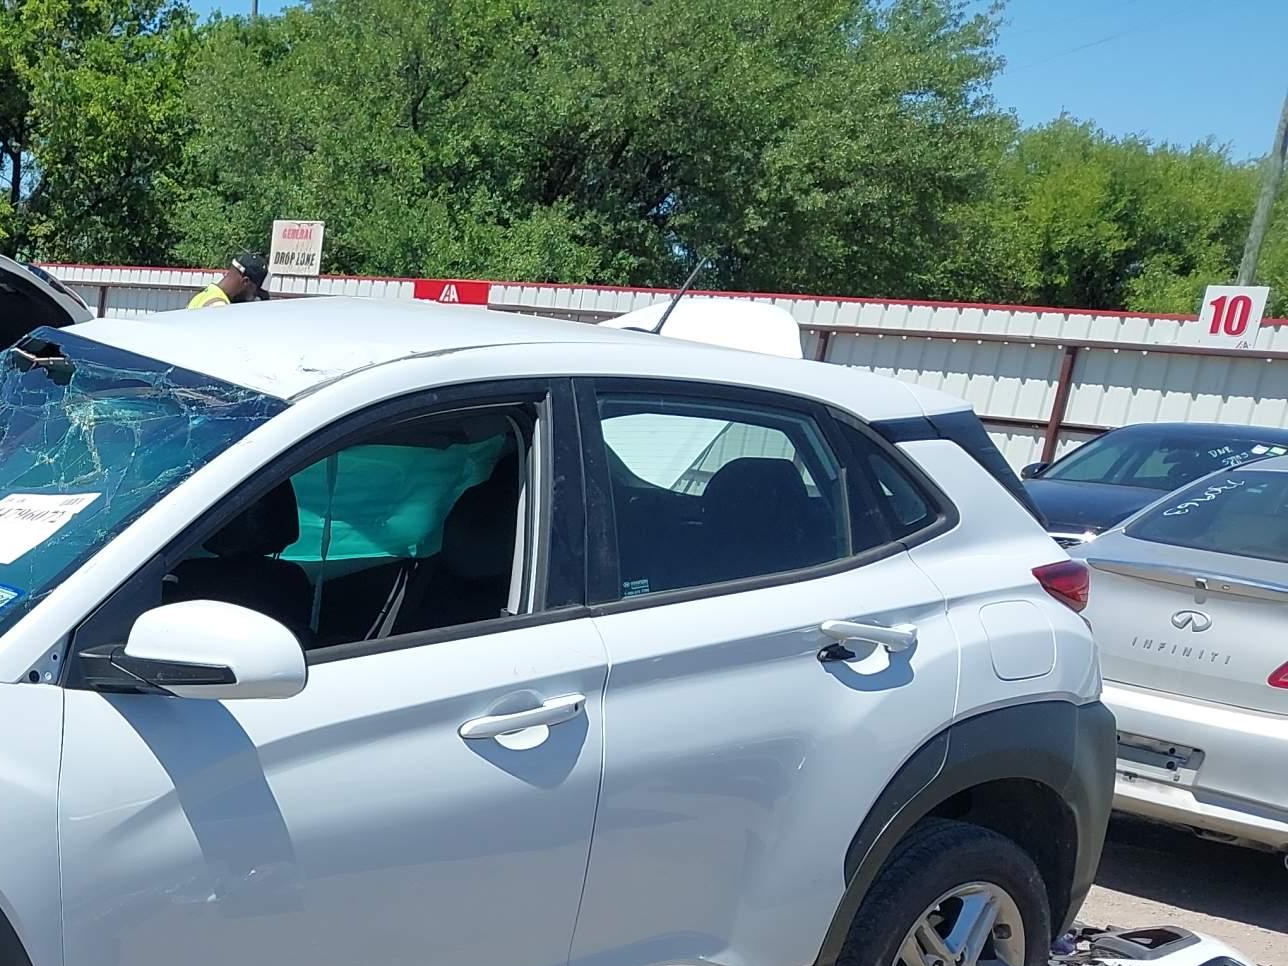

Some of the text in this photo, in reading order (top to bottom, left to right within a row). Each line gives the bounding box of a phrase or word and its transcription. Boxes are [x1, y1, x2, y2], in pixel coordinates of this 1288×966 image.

[273, 251, 296, 266] DROP
[1208, 294, 1253, 337] 10
[1132, 636, 1231, 665] INFINITI
